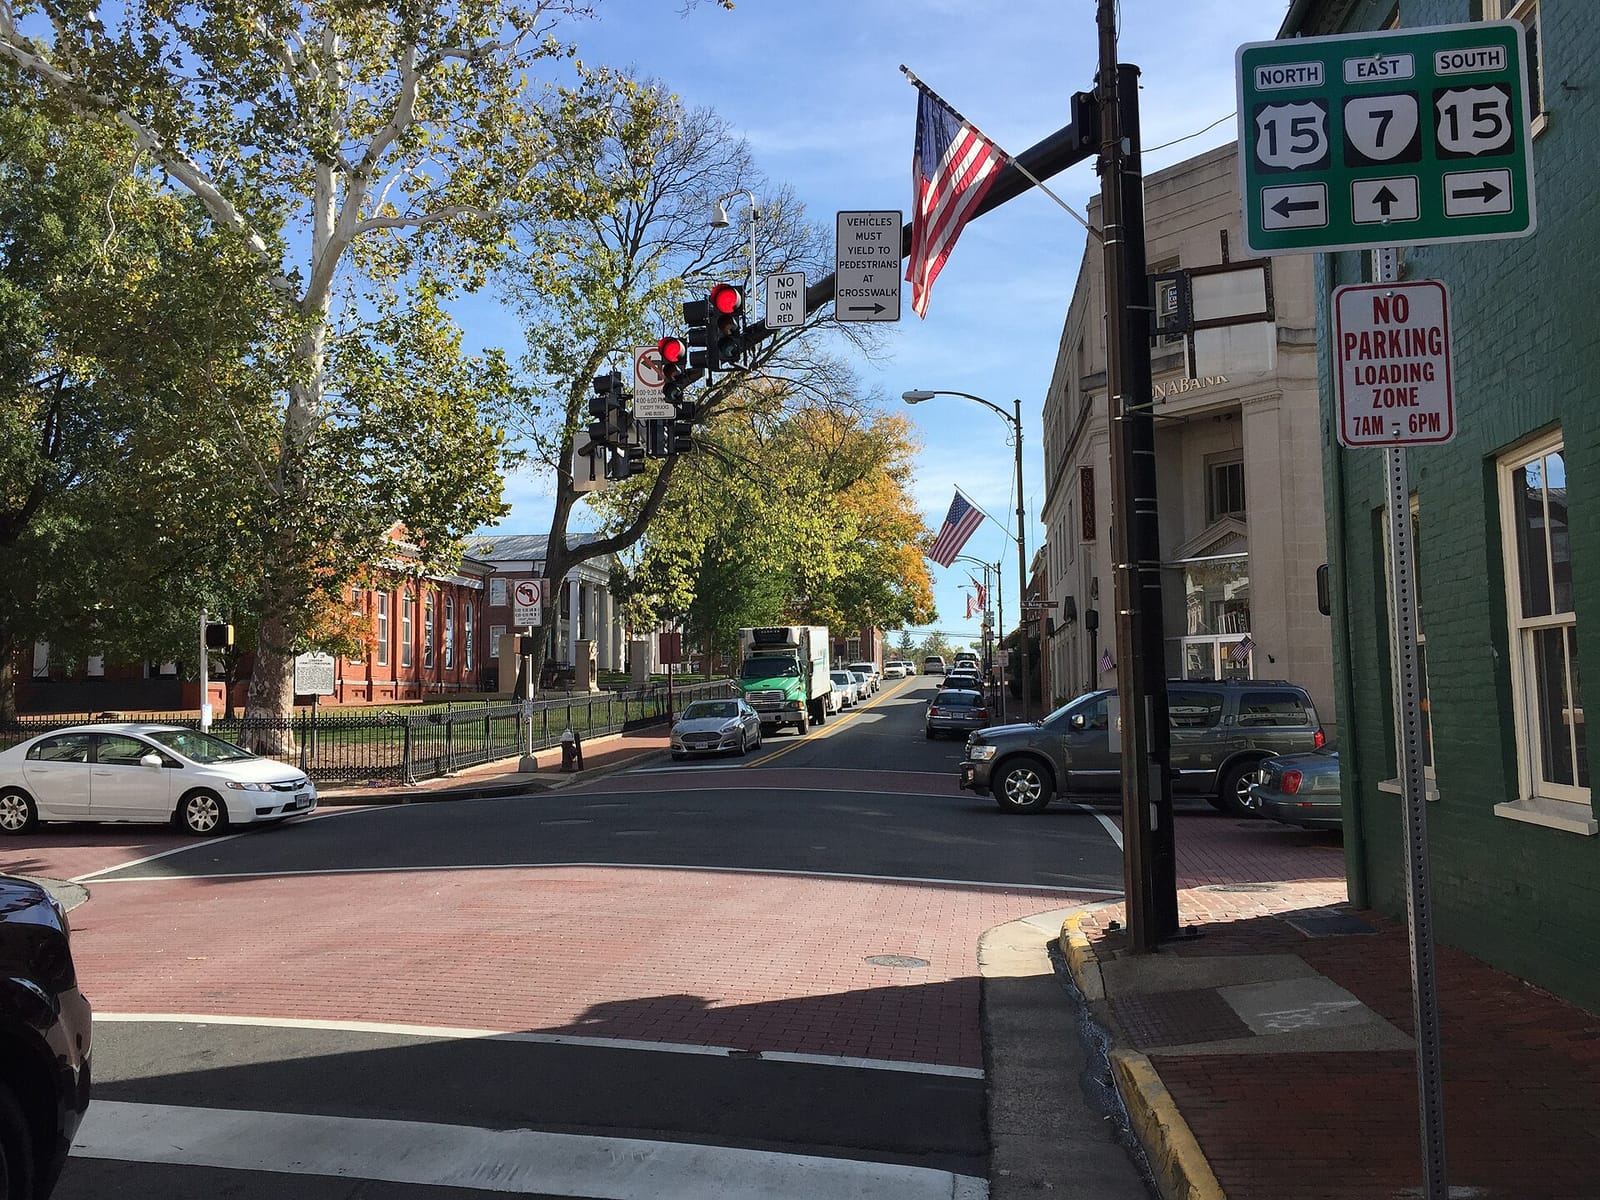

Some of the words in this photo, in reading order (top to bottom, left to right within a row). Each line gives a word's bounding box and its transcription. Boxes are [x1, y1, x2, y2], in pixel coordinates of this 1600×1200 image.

[1356, 59, 1401, 78] EAST
[1440, 50, 1501, 70] SOUTH
[1259, 65, 1319, 86] NORTH
[1368, 109, 1394, 148] 7
[1444, 101, 1501, 142] 15
[1263, 116, 1320, 156] 15
[846, 217, 892, 226] VEHICLES
[855, 232, 882, 241] MUST
[847, 246, 875, 255] YIELD
[878, 246, 891, 255] TO
[839, 260, 898, 269] PEDESTRIANS
[777, 277, 795, 288] NO
[862, 274, 874, 283] AT
[774, 290, 797, 300] TURN
[838, 288, 898, 297] CROSSWALK
[779, 302, 792, 312] ON
[1372, 293, 1409, 325] NO
[777, 313, 794, 324] RED
[1344, 326, 1442, 361] PARKING
[1354, 362, 1435, 386] LOADING
[1372, 387, 1420, 409] ZONE
[1353, 415, 1384, 436] 7AM
[1408, 412, 1441, 434] 6PM
